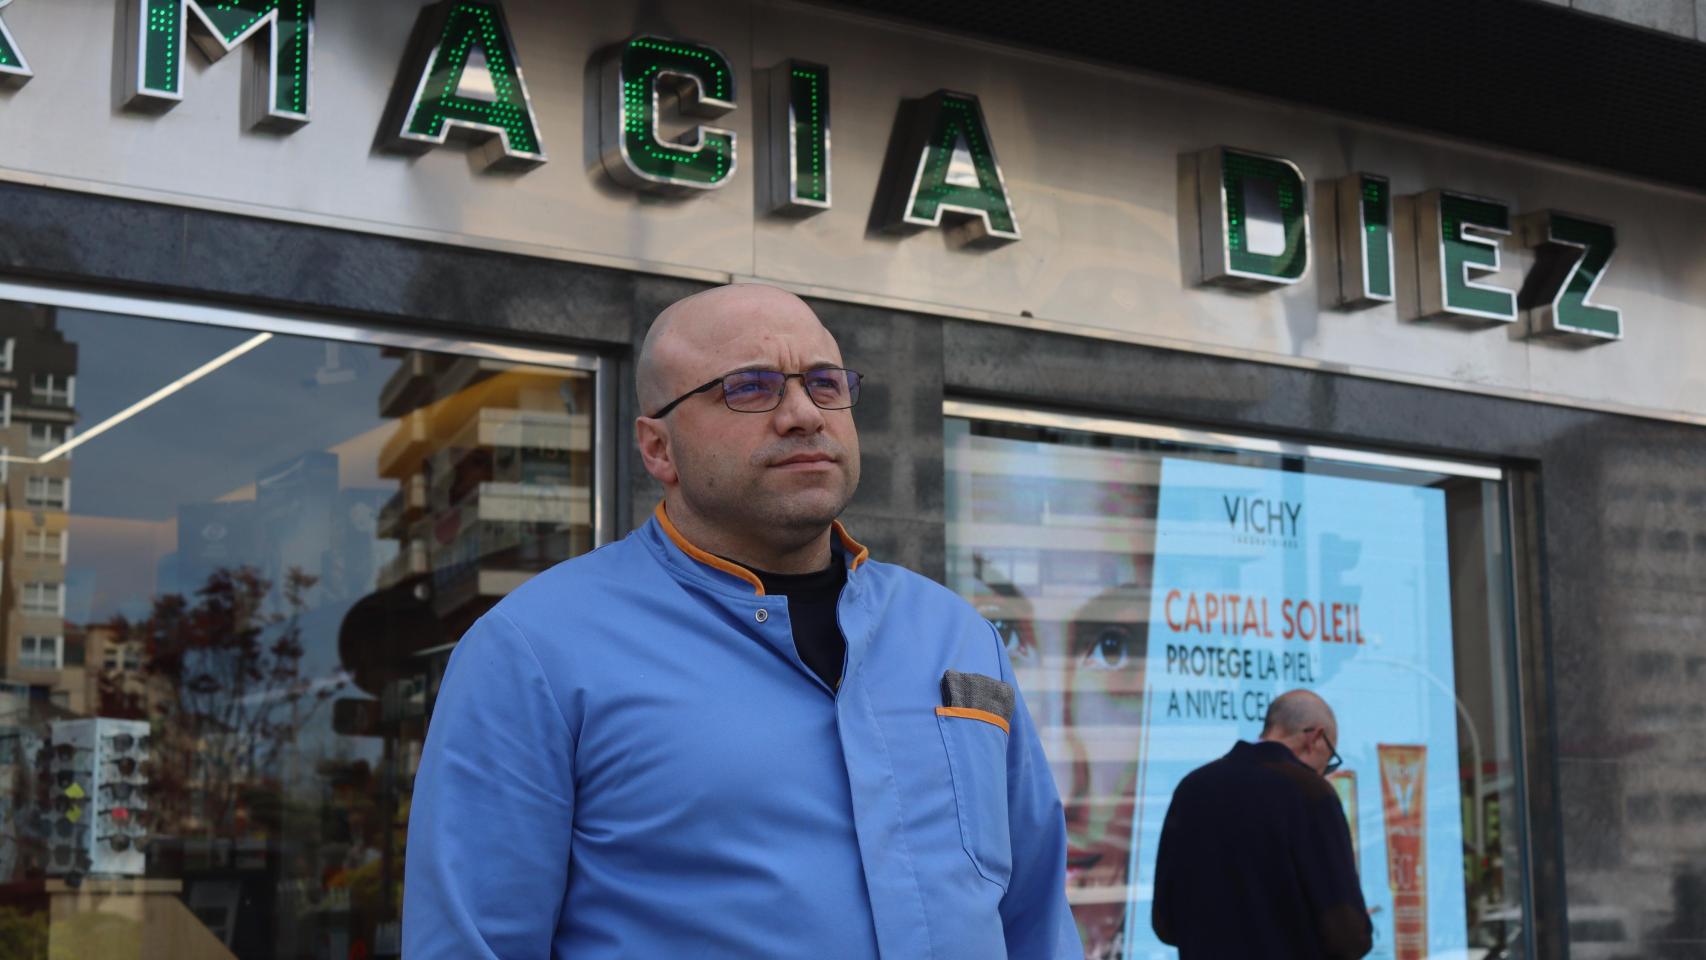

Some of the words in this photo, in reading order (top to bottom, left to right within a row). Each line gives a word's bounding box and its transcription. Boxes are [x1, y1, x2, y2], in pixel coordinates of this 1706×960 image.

[0, 0, 1021, 240] MACIA
[1220, 145, 1623, 340] DIEZ
[1223, 495, 1302, 537] VICHY
[1164, 589, 1274, 638] CAPITAL
[1281, 598, 1365, 645] SOLEIL
[1166, 643, 1253, 680] PROTEGE
[1257, 650, 1279, 681] LA
[1283, 651, 1315, 684] PIEL
[1167, 689, 1181, 718] A
[1185, 689, 1238, 721] NIVEL
